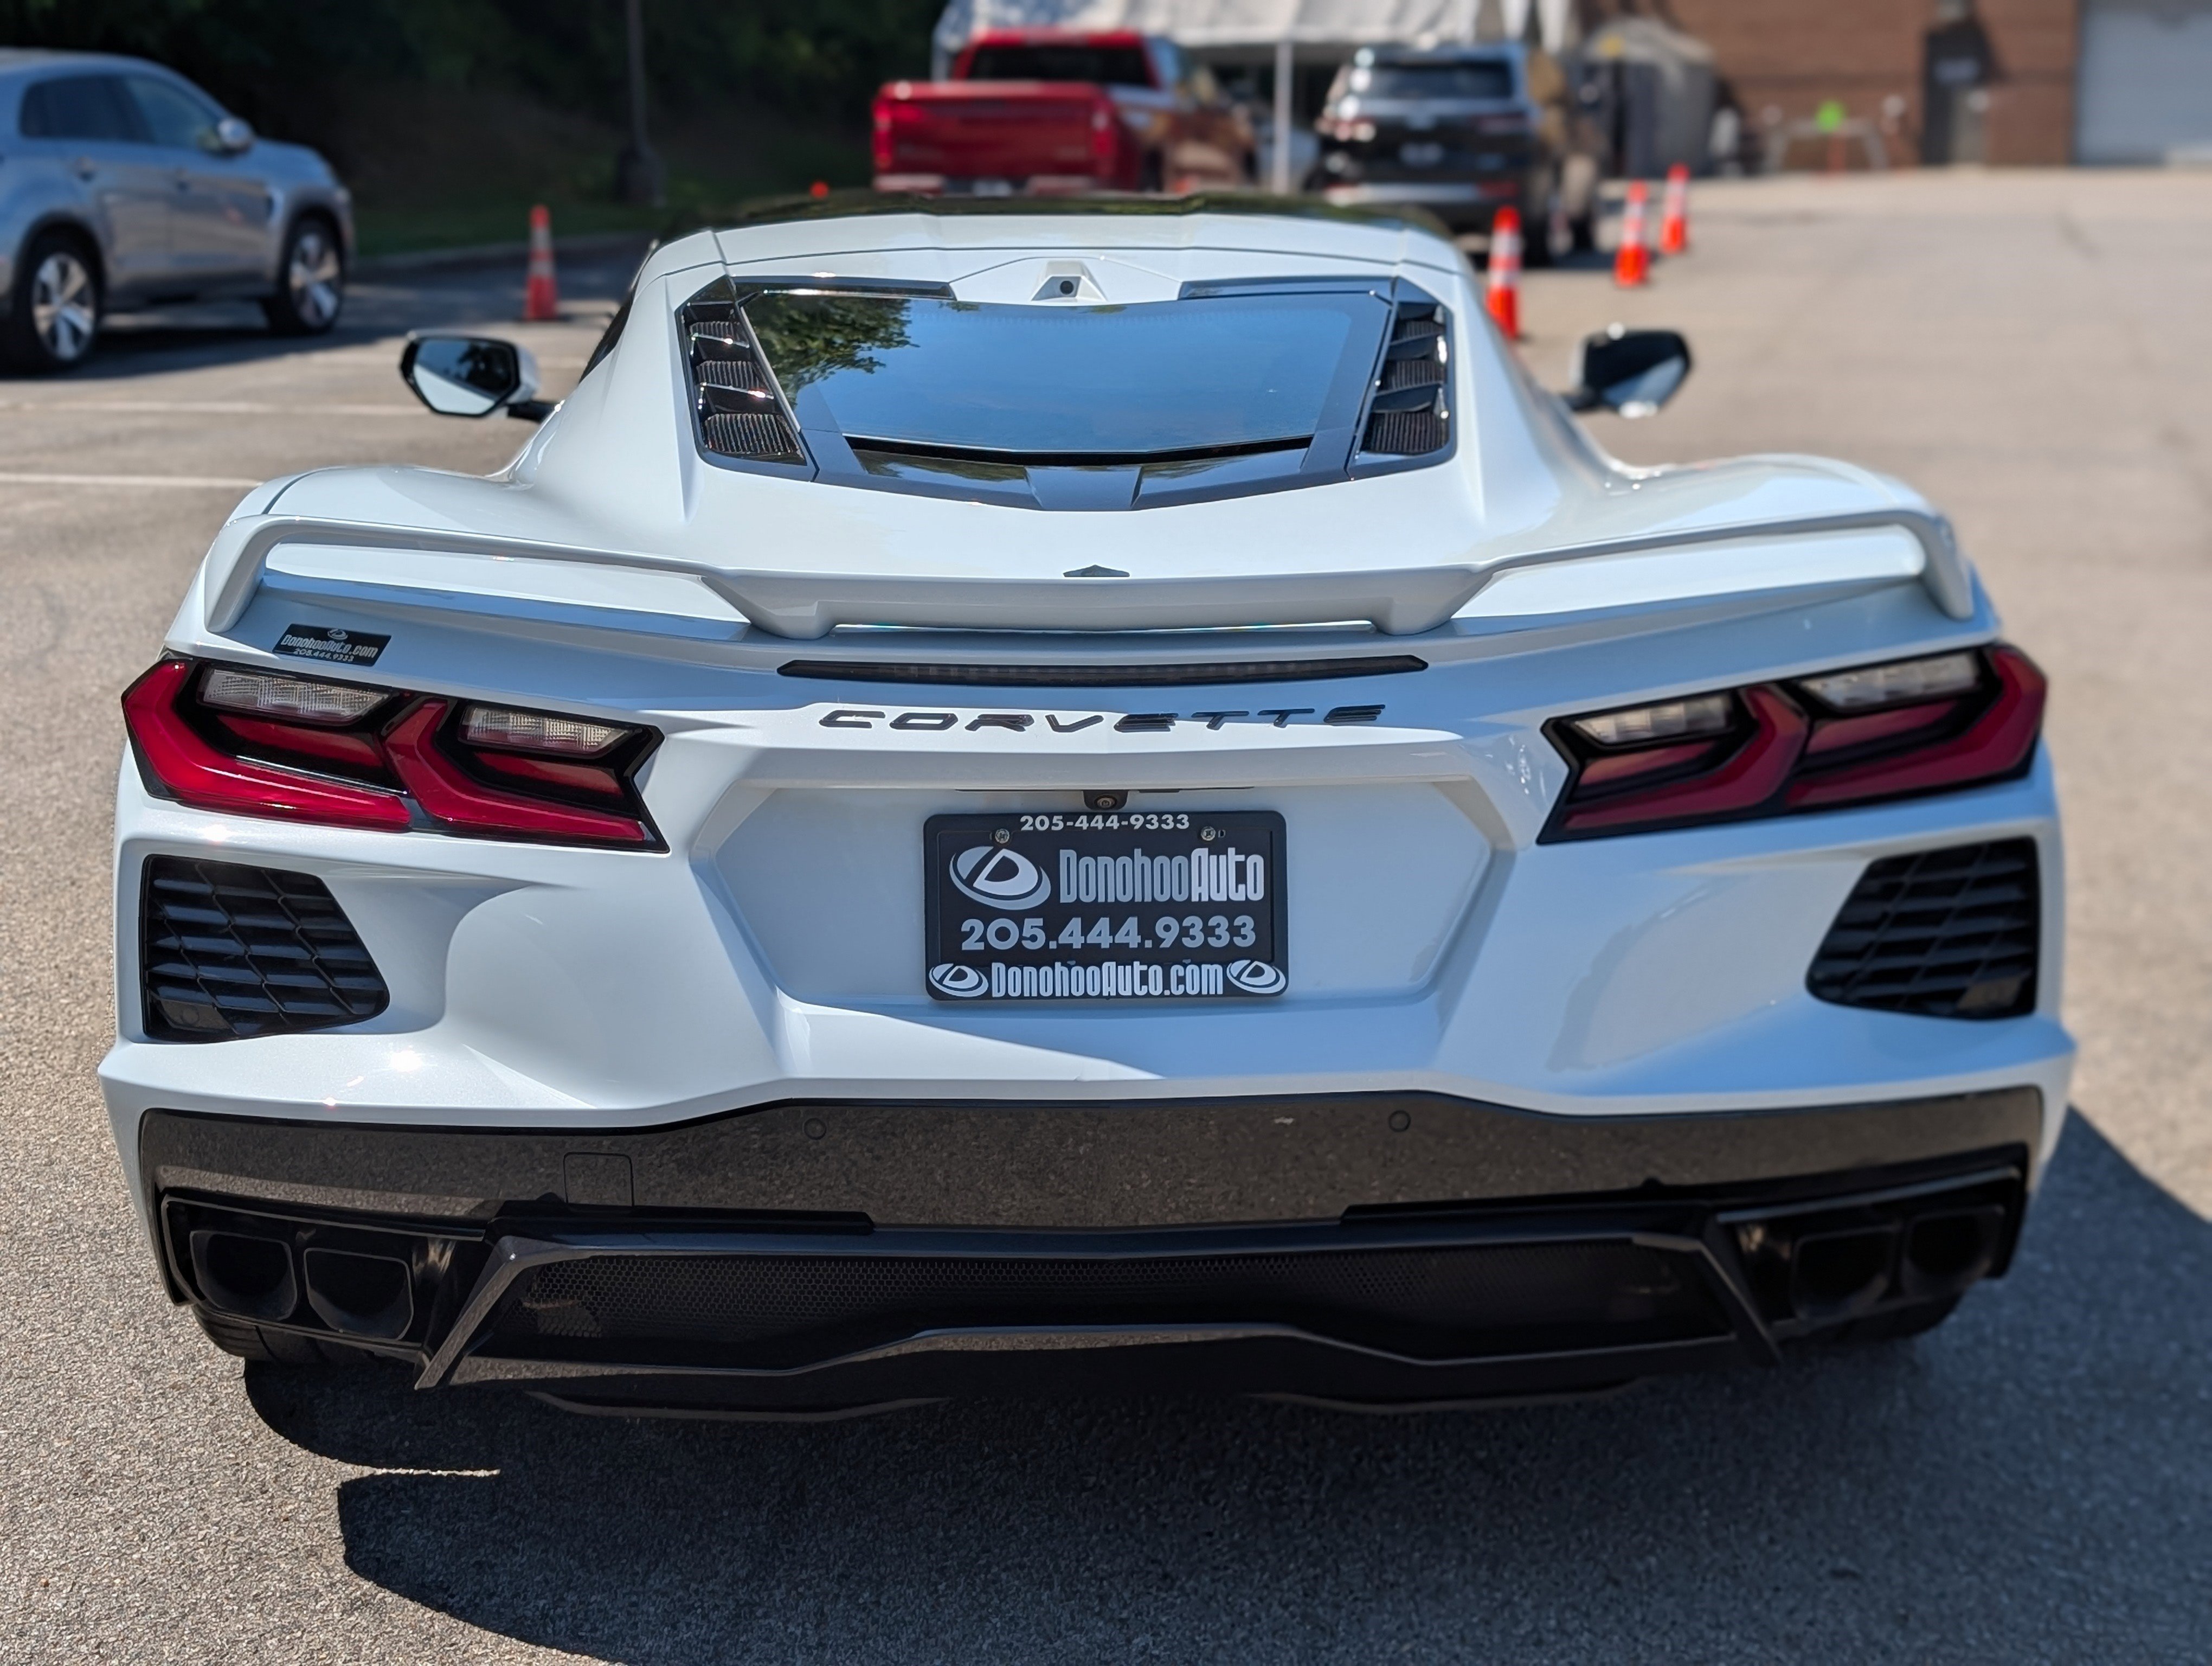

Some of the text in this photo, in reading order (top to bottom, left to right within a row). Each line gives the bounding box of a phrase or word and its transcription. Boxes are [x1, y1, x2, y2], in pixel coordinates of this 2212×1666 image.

[280, 634, 378, 658] DonohooAuto.com
[818, 703, 1386, 734] CORVETTE
[1019, 814, 1190, 831] 205-444-9333
[1059, 847, 1264, 904] DonohooAuto
[961, 915, 1256, 951] 205.444.9333
[991, 960, 1224, 998] DonohooAuto.com
